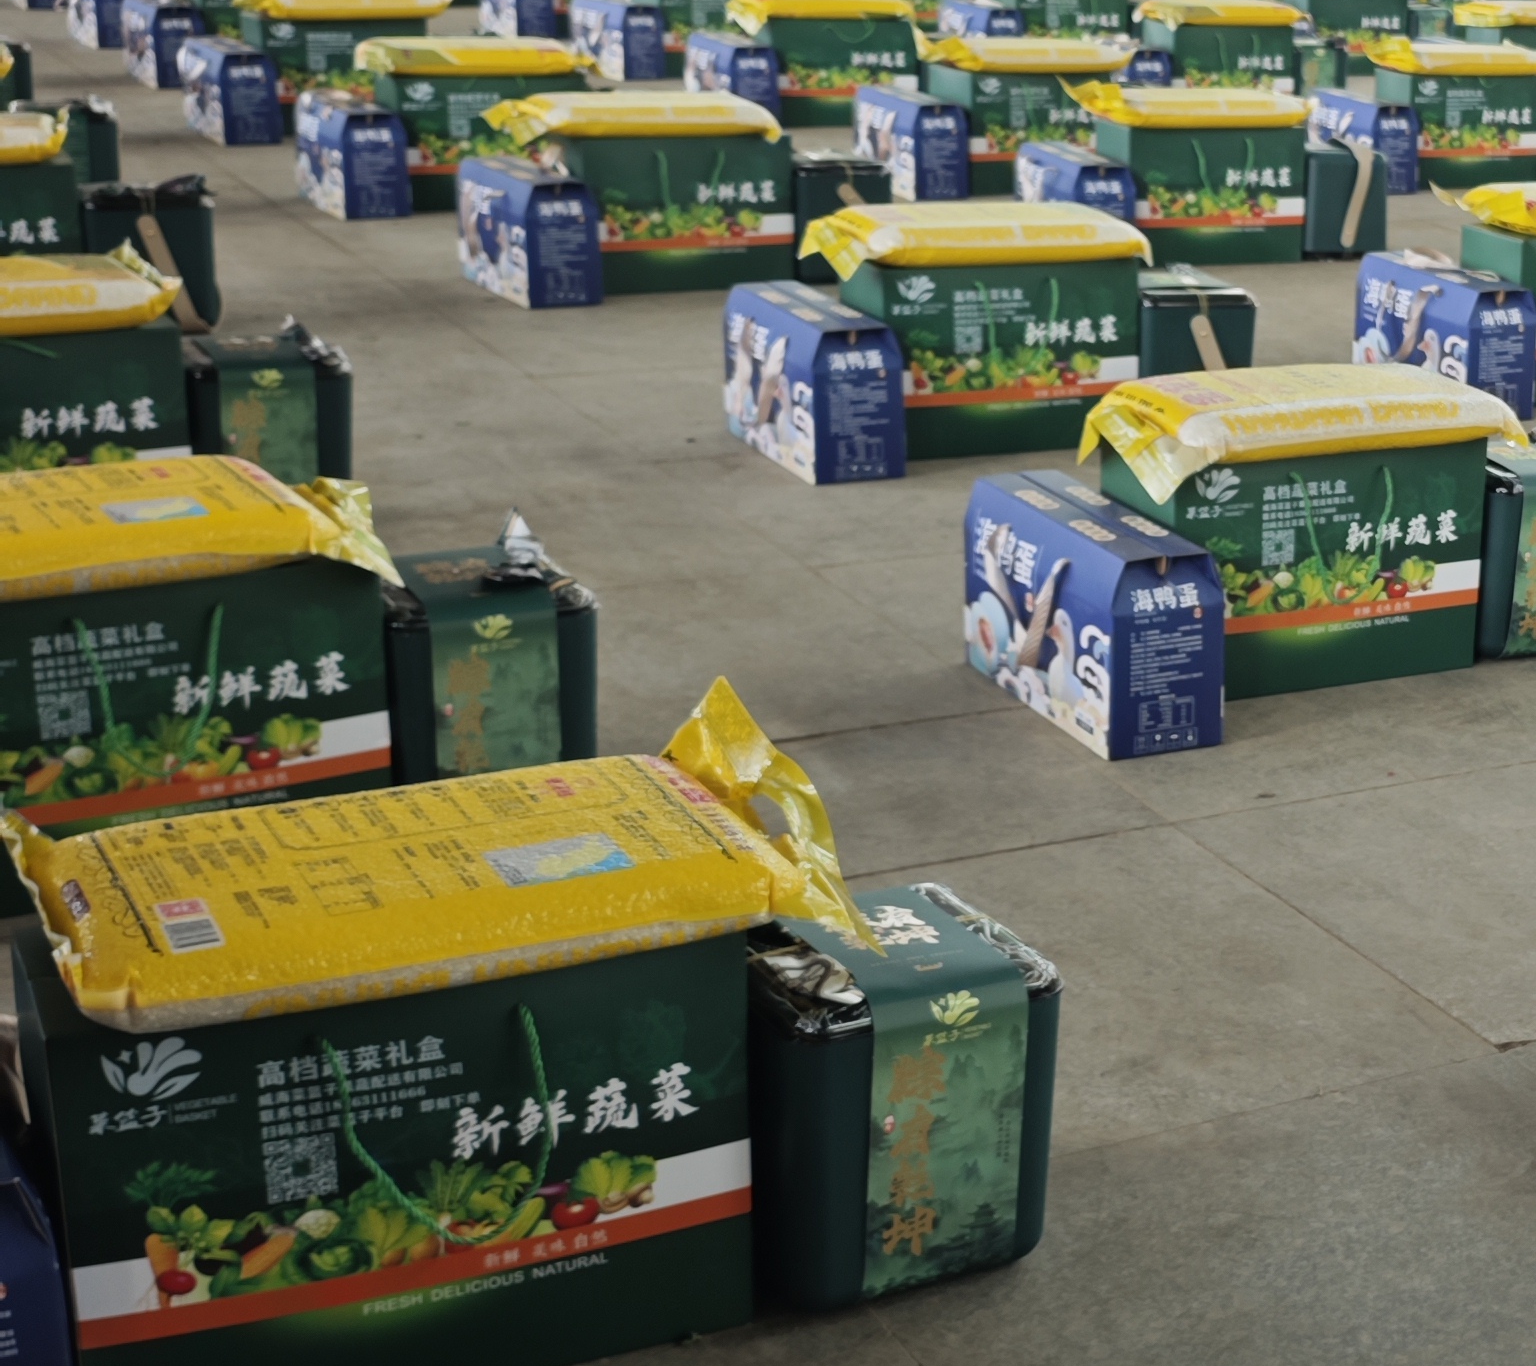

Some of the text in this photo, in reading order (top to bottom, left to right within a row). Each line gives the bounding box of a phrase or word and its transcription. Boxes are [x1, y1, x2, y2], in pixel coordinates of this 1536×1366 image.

[1225, 165, 1291, 188] 新鲜蔬菜
[1024, 315, 1118, 346] 新鲜蔬菜
[1479, 307, 1523, 327] 海鸭蛋
[21, 396, 159, 439] 新鲜蔬菜
[1345, 509, 1458, 553] 新鲜蔬菜
[1130, 582, 1200, 613] 海鸭蛋
[173, 650, 352, 715] 新鲜蔬菜
[256, 1034, 446, 1089] 高档蔬菜礼盒
[452, 1061, 700, 1160] 新鲜蔬菜
[362, 1252, 609, 1317] FRESH DELICIOUS NATURAL
